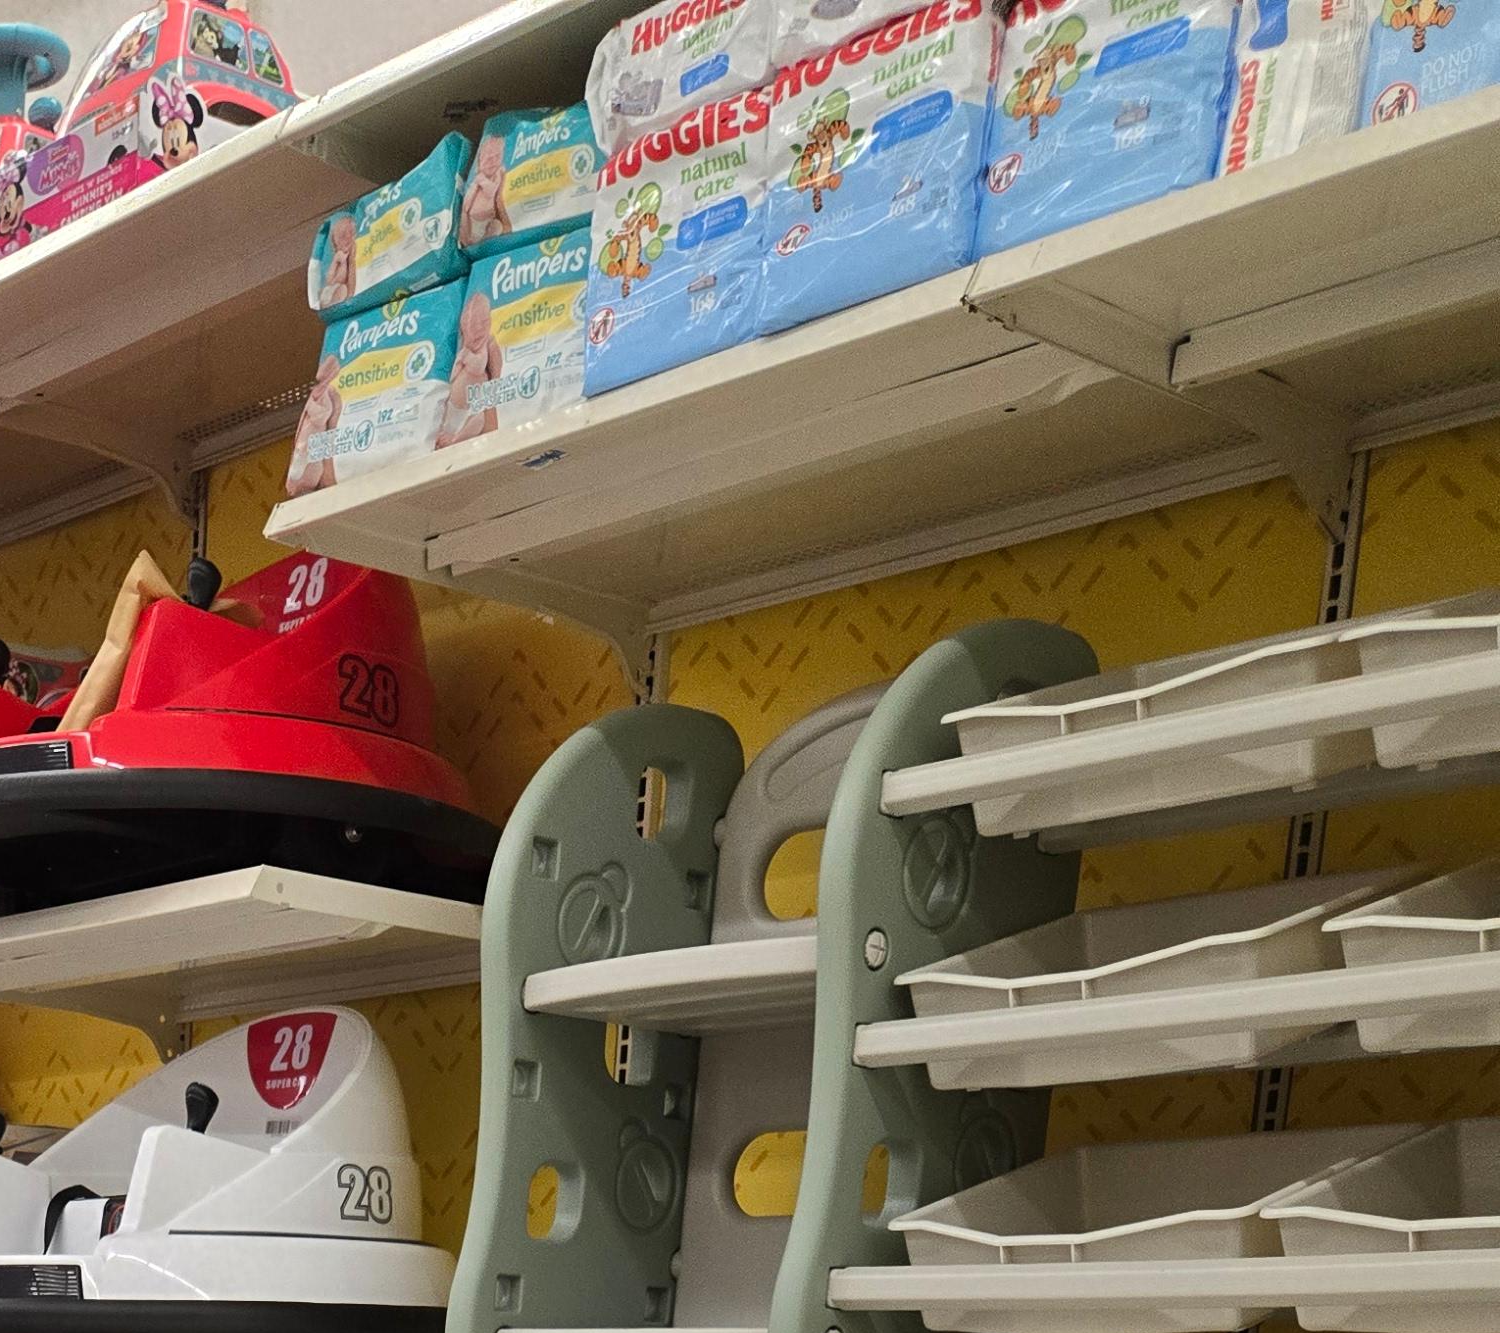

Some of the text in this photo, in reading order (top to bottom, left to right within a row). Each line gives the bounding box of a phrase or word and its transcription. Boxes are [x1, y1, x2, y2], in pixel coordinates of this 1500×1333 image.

[872, 30, 955, 86] natural
[885, 65, 940, 99] care
[1226, 59, 1261, 176] HUGGIES
[680, 142, 747, 185] natural
[694, 176, 738, 201] care
[492, 246, 587, 300] Pampers
[340, 310, 420, 360] Pampers
[338, 362, 400, 389] sensitive
[283, 558, 328, 614] 28
[338, 653, 399, 728] 28
[269, 1024, 313, 1073] 28
[265, 1077, 292, 1090] SUPER
[337, 1163, 393, 1225] 28
